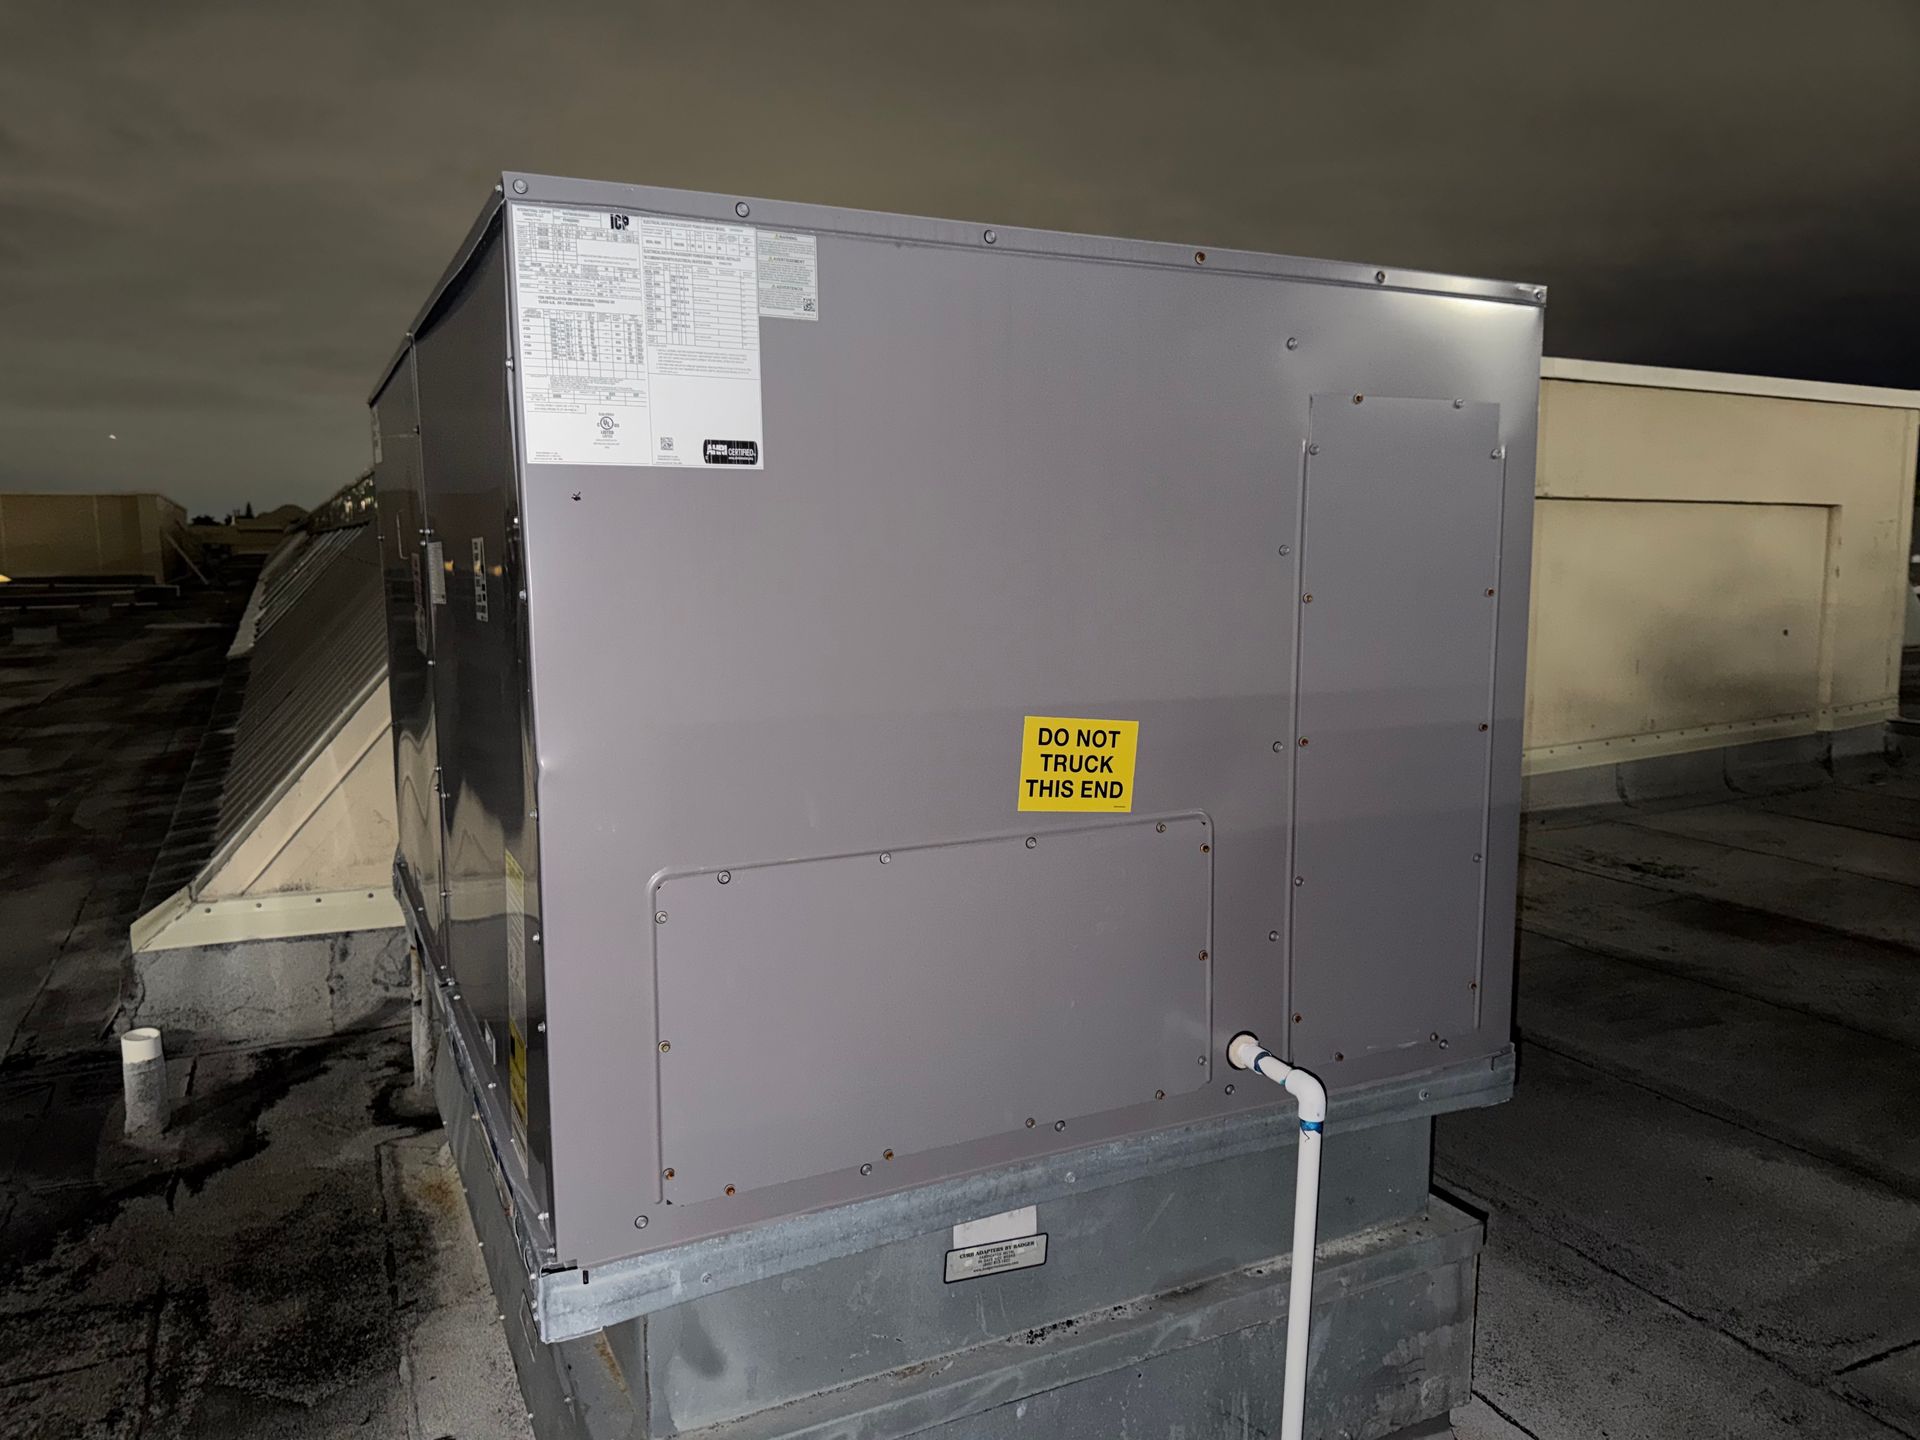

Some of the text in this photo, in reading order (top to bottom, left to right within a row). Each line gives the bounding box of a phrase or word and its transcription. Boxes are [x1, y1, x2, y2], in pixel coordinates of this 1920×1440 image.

[609, 213, 630, 231] ICP
[728, 448, 754, 457] CERTIFIED
[1038, 727, 1121, 749] DO NOT
[1040, 753, 1114, 774] TRUCK
[1025, 779, 1123, 799] THIS END
[976, 1246, 1004, 1256] ADAPTERS
[1013, 1241, 1035, 1249] BADGER
